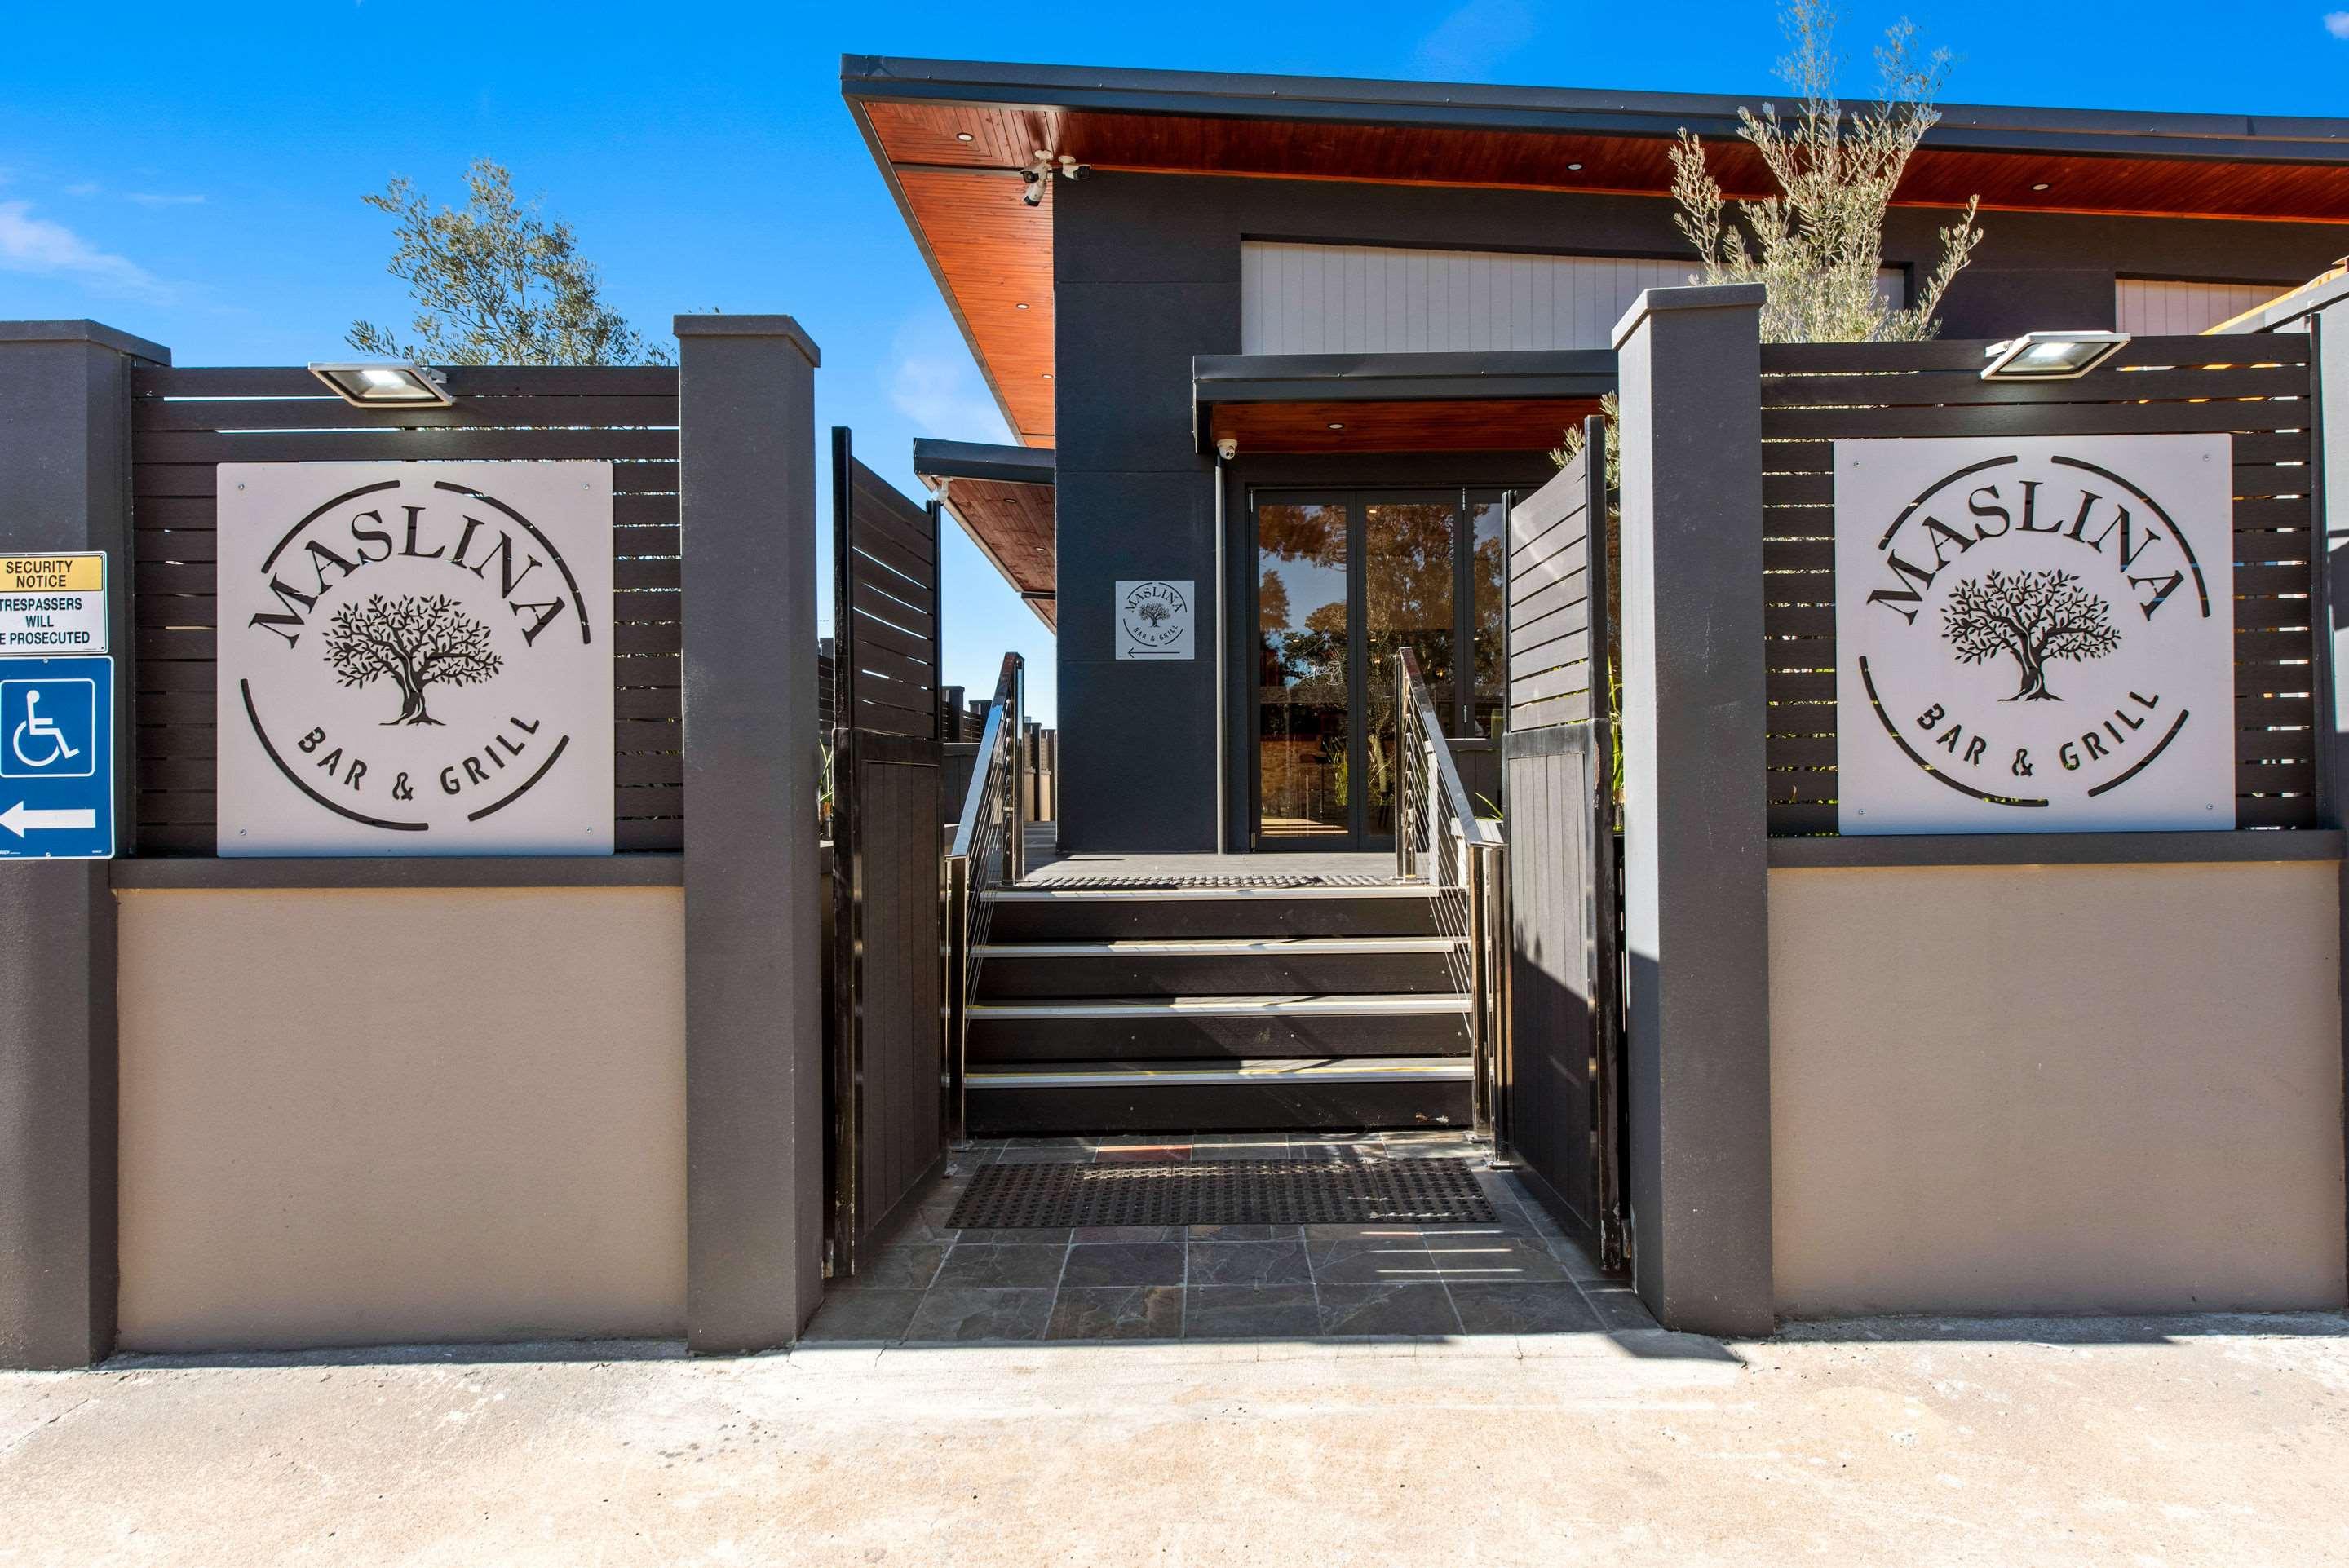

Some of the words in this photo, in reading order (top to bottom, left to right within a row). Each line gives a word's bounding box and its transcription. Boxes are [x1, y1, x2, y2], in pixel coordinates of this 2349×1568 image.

[1866, 479, 2184, 626] MASLINA
[6, 560, 73, 574] SECURITY
[16, 575, 67, 588] NOTICE
[248, 505, 565, 649] MASLINA
[0, 598, 82, 612] TRESPASSERS
[1125, 586, 1183, 613] MASLINA
[25, 615, 54, 628] WILL
[0, 633, 6, 644] E
[10, 631, 90, 644] PROSECUTED
[1134, 627, 1147, 640] BAR
[1159, 625, 1178, 641] GRILL
[1916, 703, 1987, 766] BAR
[2012, 748, 2033, 776] &
[2059, 691, 2158, 771] GRILL
[297, 726, 367, 791] BAR
[392, 771, 414, 800] &
[440, 717, 540, 795] GRILL
